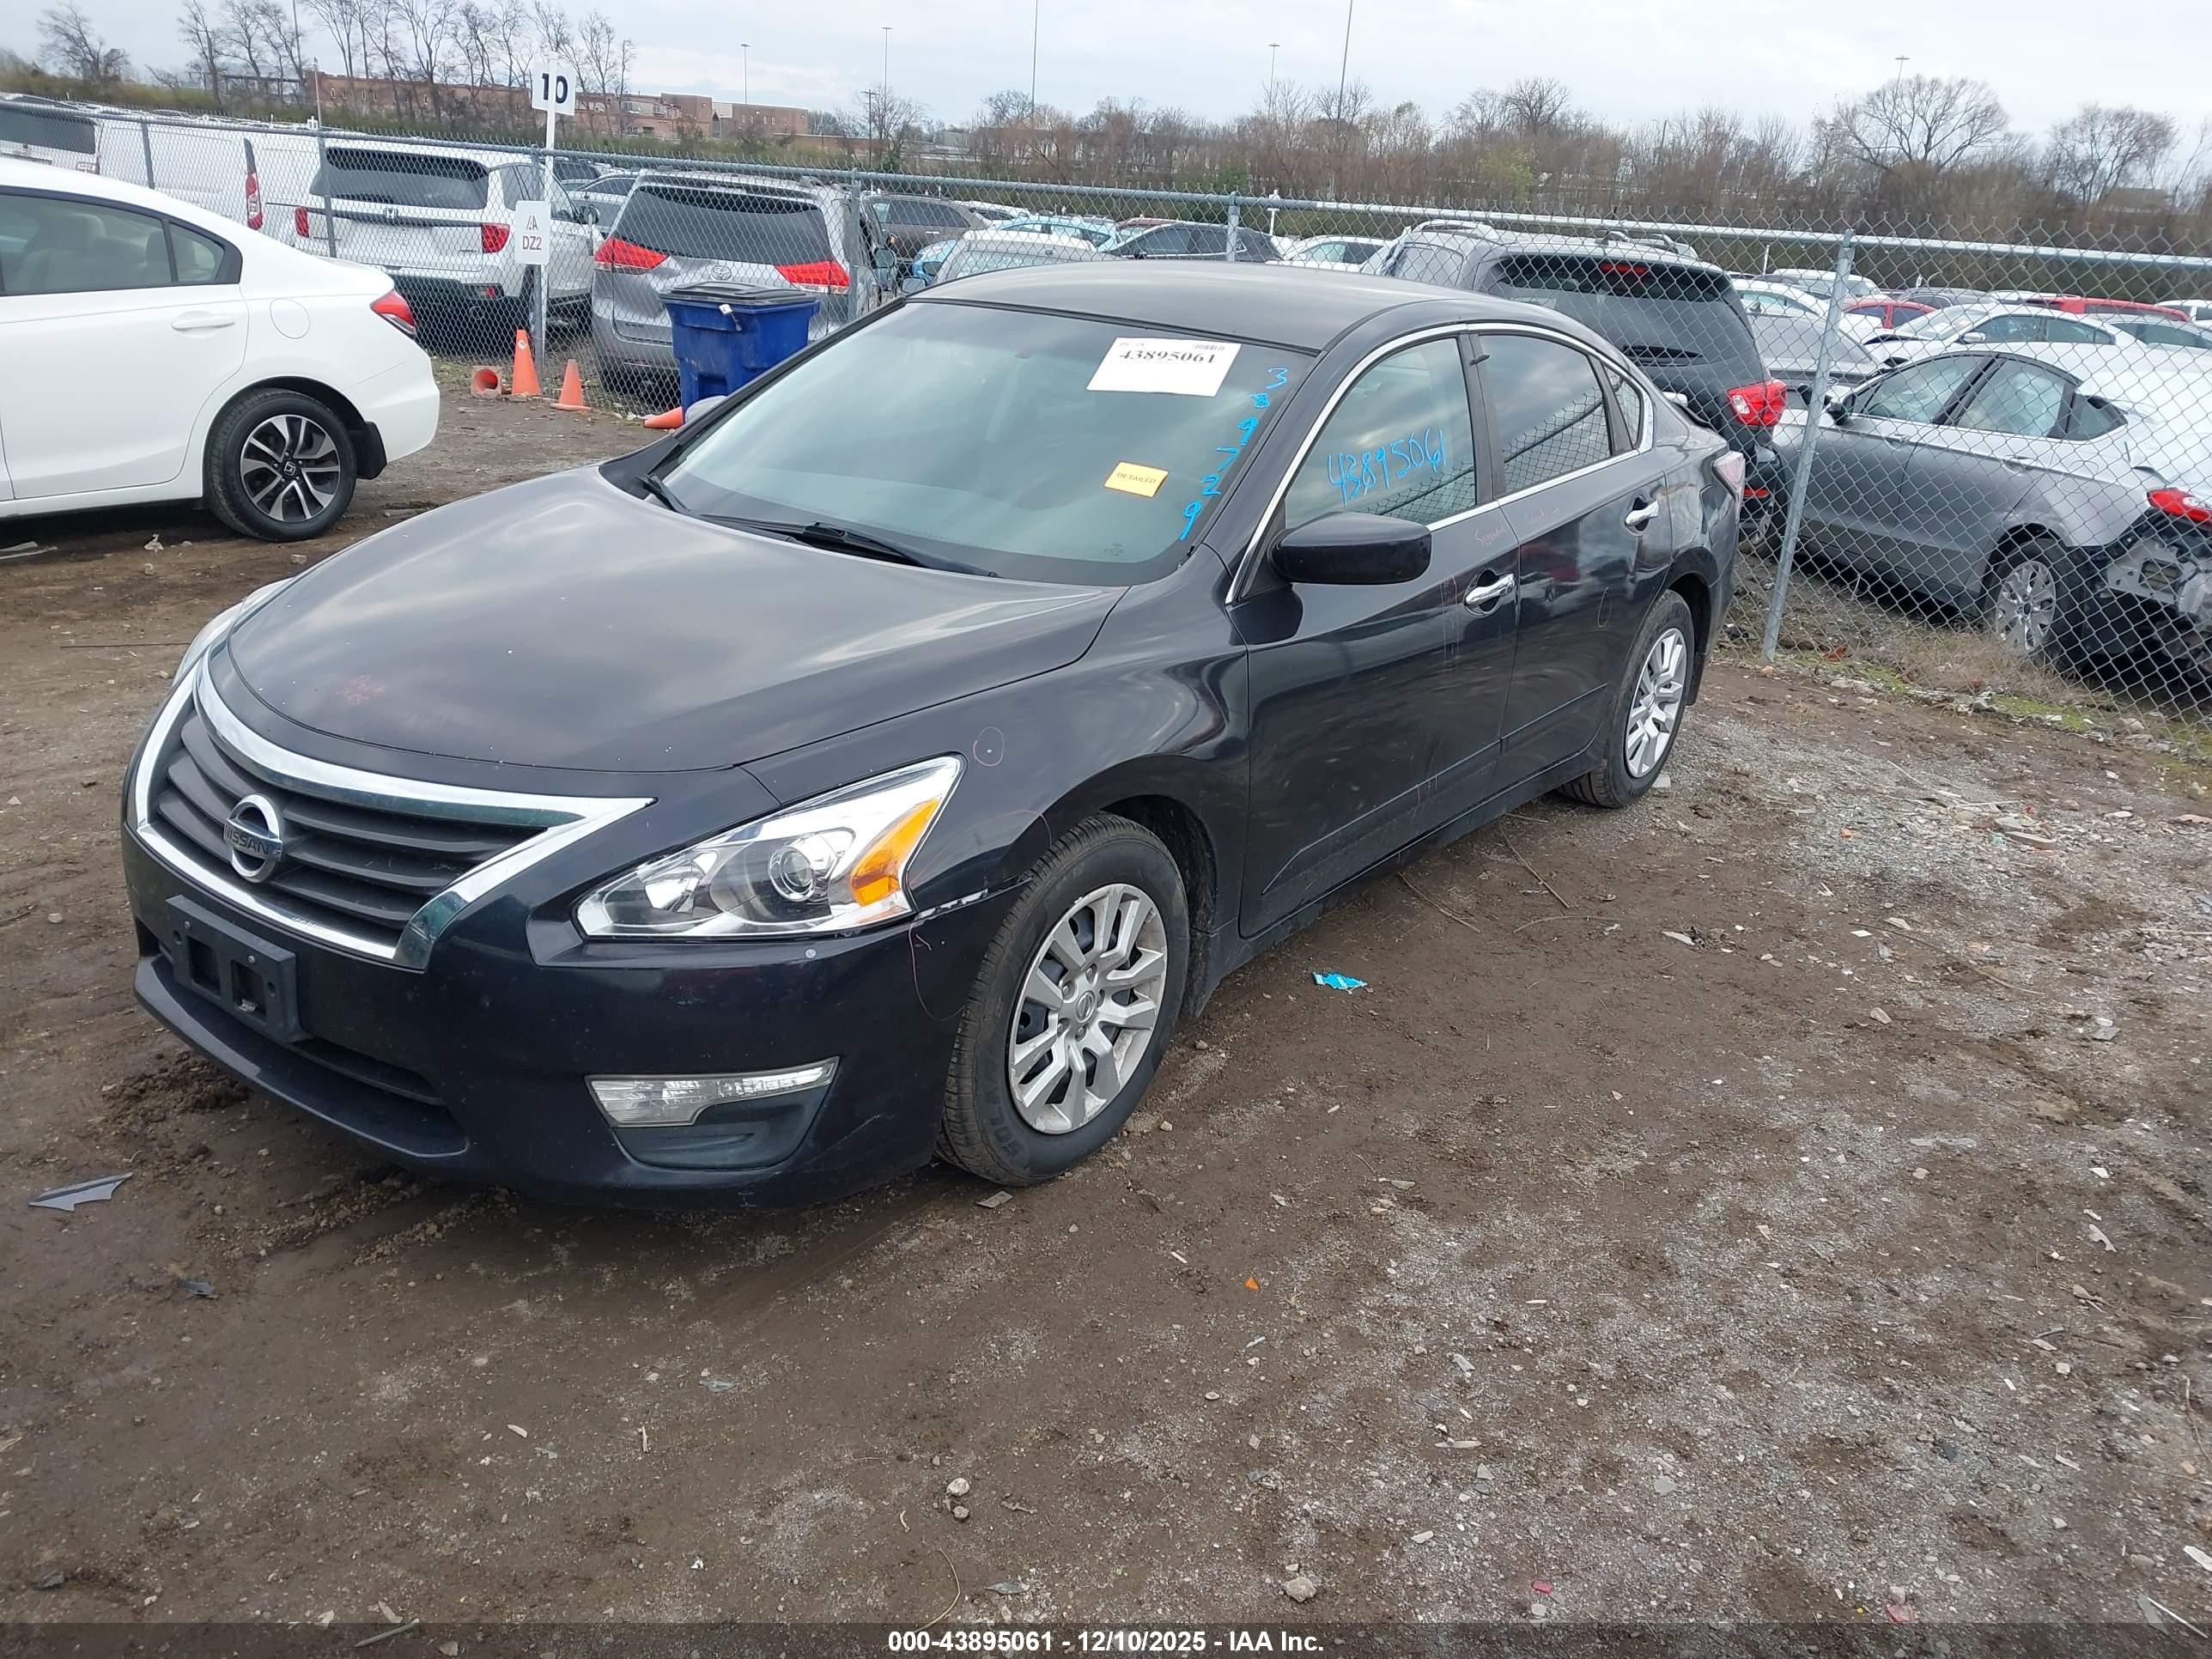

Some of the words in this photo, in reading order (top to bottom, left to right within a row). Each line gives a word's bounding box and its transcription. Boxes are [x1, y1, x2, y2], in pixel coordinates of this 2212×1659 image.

[542, 73, 568, 104] 10
[522, 235, 542, 250] DZ2
[1119, 349, 1216, 363] 43895061
[1328, 428, 1447, 508] 43895061
[225, 825, 269, 855] NISSAN
